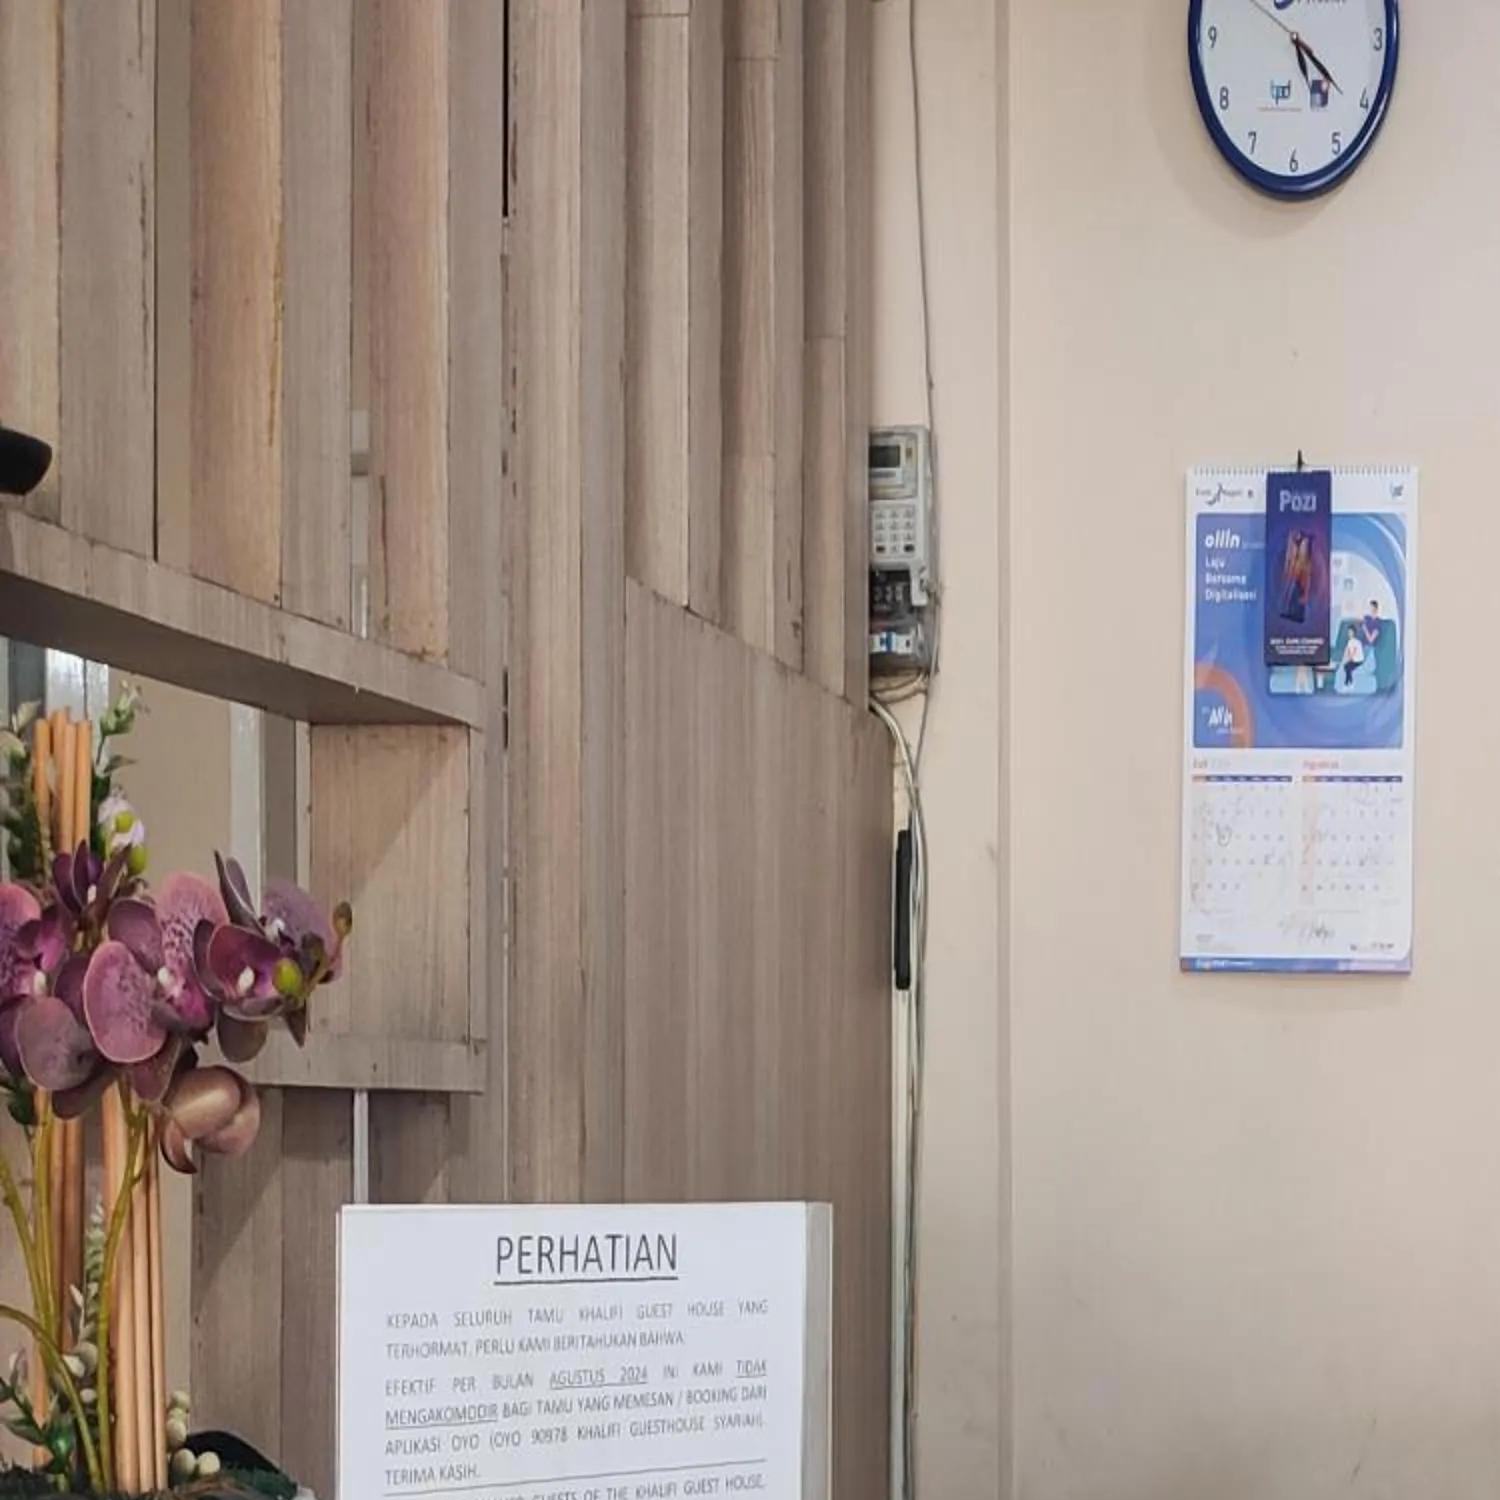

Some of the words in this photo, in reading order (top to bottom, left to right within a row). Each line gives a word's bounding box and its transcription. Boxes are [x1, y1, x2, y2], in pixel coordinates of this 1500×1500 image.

[1208, 26, 1217, 48] 9
[1373, 27, 1383, 51] 3
[1219, 86, 1229, 110] 8
[1359, 88, 1369, 110] 4
[1248, 131, 1257, 154] 7
[1331, 131, 1341, 154] 5
[1289, 150, 1298, 172] 6
[496, 1232, 678, 1276] PERHATIAN
[387, 1312, 438, 1329] KEPADA
[453, 1308, 512, 1327] SELURUH
[528, 1307, 564, 1325] TAMU
[636, 1303, 673, 1320] GUEST
[687, 1300, 724, 1317] HOUSE
[737, 1298, 769, 1315] YANG
[476, 1337, 515, 1355] PERLU
[518, 1336, 550, 1352] KAMI
[385, 1377, 436, 1397] EFEKTIF
[452, 1375, 476, 1393] PER
[492, 1371, 534, 1391] BULAN
[550, 1368, 605, 1388] AGUSTUS
[620, 1365, 648, 1383] 2024
[693, 1360, 723, 1377] KAMI
[736, 1359, 767, 1375] TIDAK
[503, 1400, 532, 1418] BAGI
[537, 1398, 573, 1415] TAMU
[578, 1395, 610, 1413] YANG
[687, 1387, 737, 1405] BOOKING
[741, 1384, 767, 1401] DARI
[385, 1436, 440, 1456] APLIKASI
[451, 1433, 479, 1452] OYO
[490, 1430, 521, 1451] (OYO
[531, 1426, 567, 1445] 90978
[629, 1415, 705, 1437] GUESTHOUSE
[385, 1466, 434, 1486] TERIMA
[684, 1477, 720, 1496] GUEST
